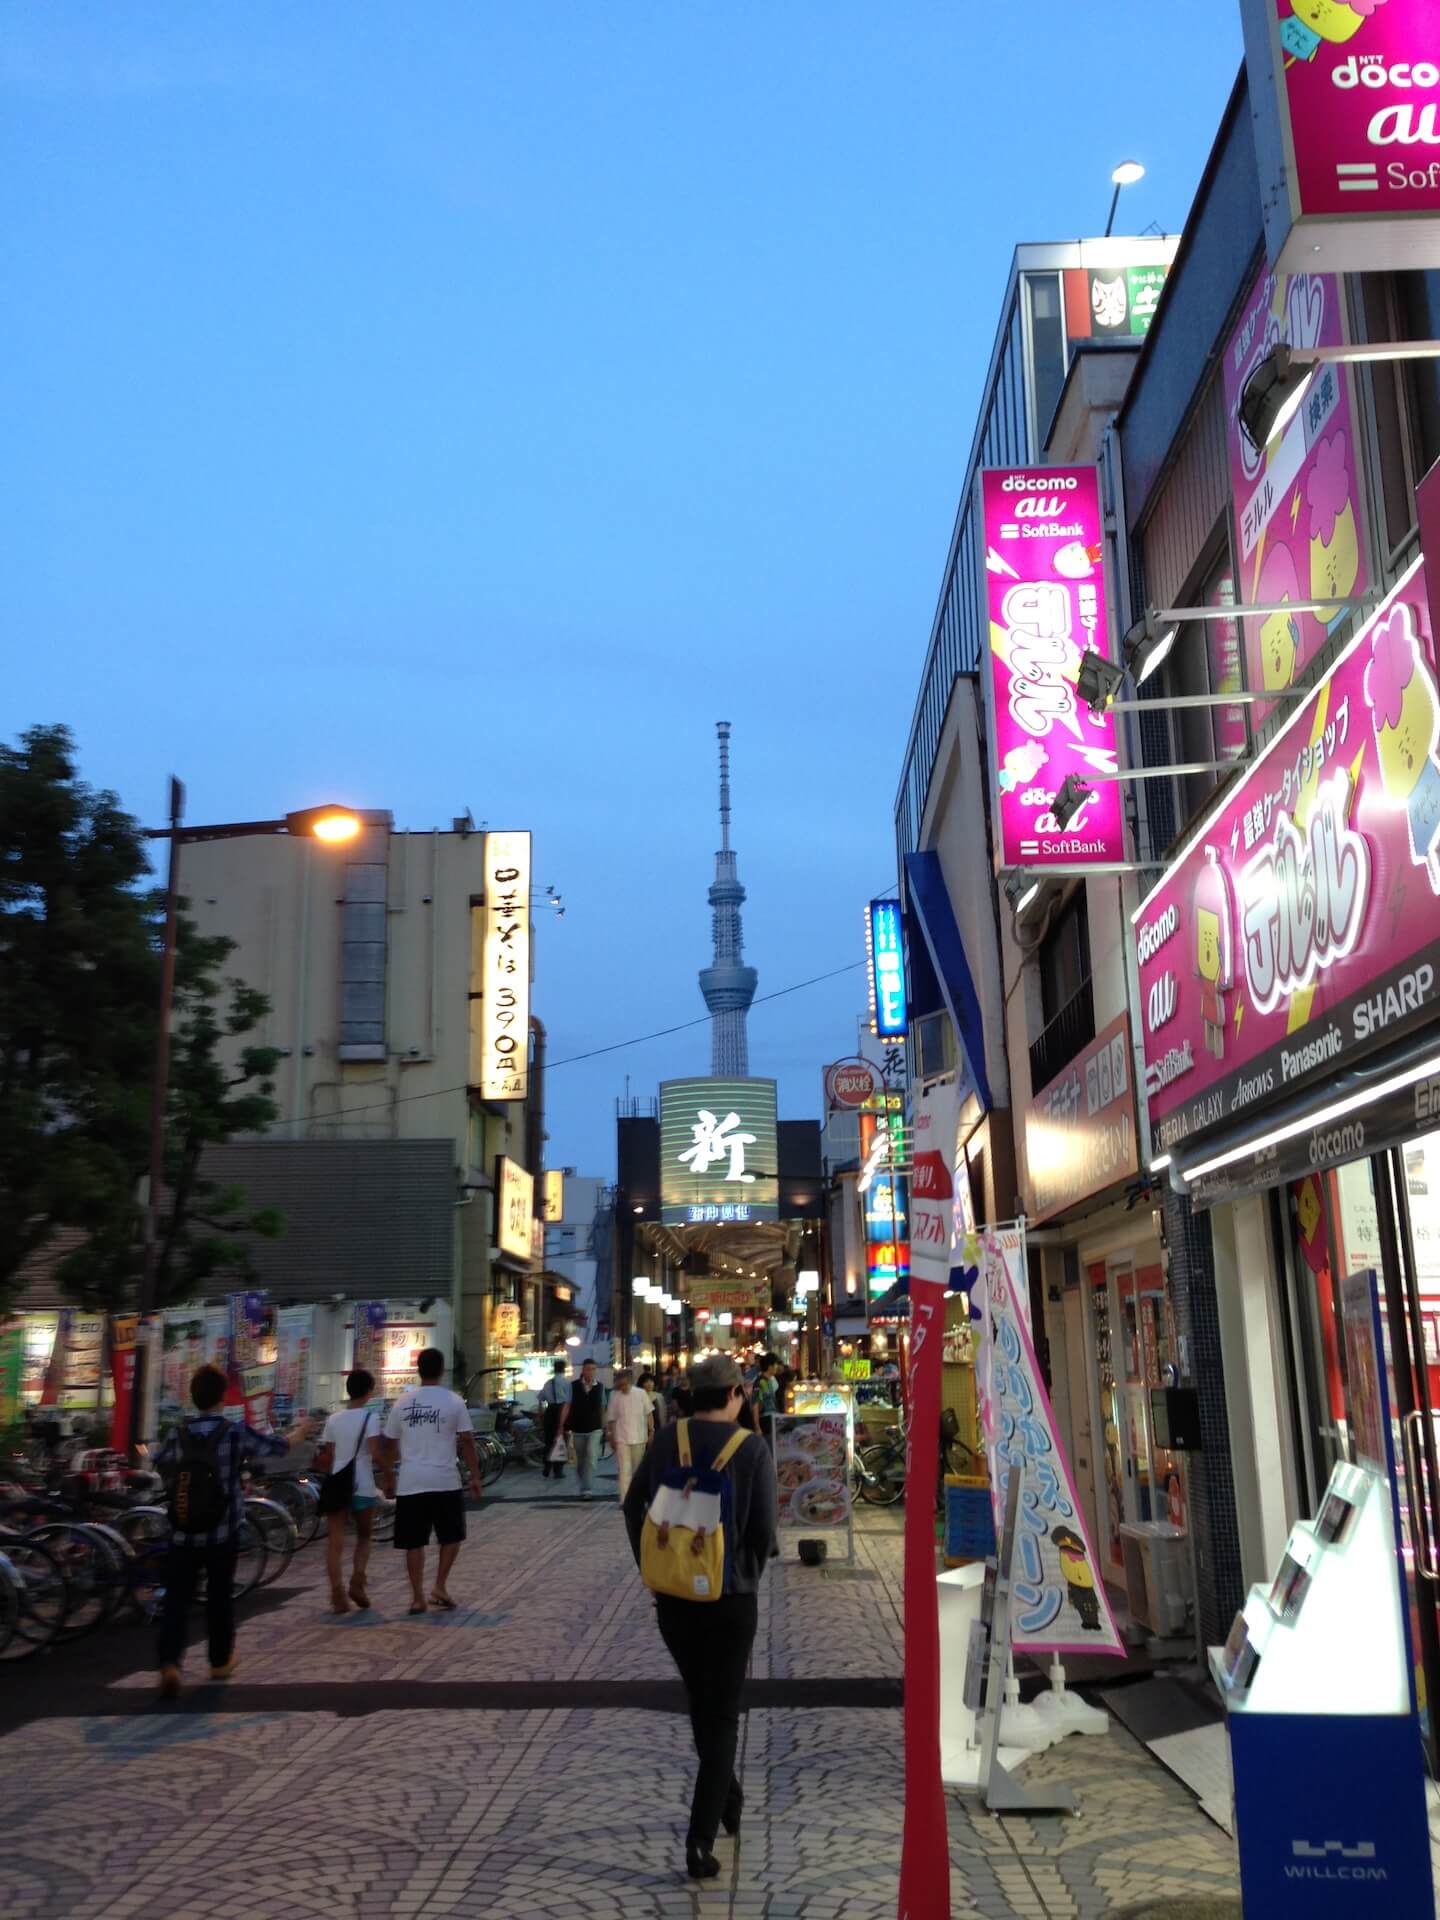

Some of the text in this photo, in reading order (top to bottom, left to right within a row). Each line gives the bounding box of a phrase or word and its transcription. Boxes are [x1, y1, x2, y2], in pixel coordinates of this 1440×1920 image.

[1001, 475, 1078, 491] docomo
[1014, 496, 1067, 518] au
[1021, 522, 1085, 538] SoftBank
[1243, 480, 1274, 549] テルル
[1242, 695, 1349, 852] 最強ケータイショップ
[1042, 839, 1106, 856] SoftBank
[1137, 904, 1176, 967] docomo
[1149, 970, 1174, 1033] au
[1353, 963, 1434, 1040] SHARP
[838, 1075, 872, 1093] 消火栓
[1154, 1112, 1190, 1153] XPERIA
[1192, 1090, 1224, 1131] GALAXY
[1280, 1023, 1342, 1082] Panasonic
[677, 1109, 757, 1183] 新
[1309, 1120, 1365, 1166] docomo
[1284, 1865, 1388, 1881] WILLCOM
